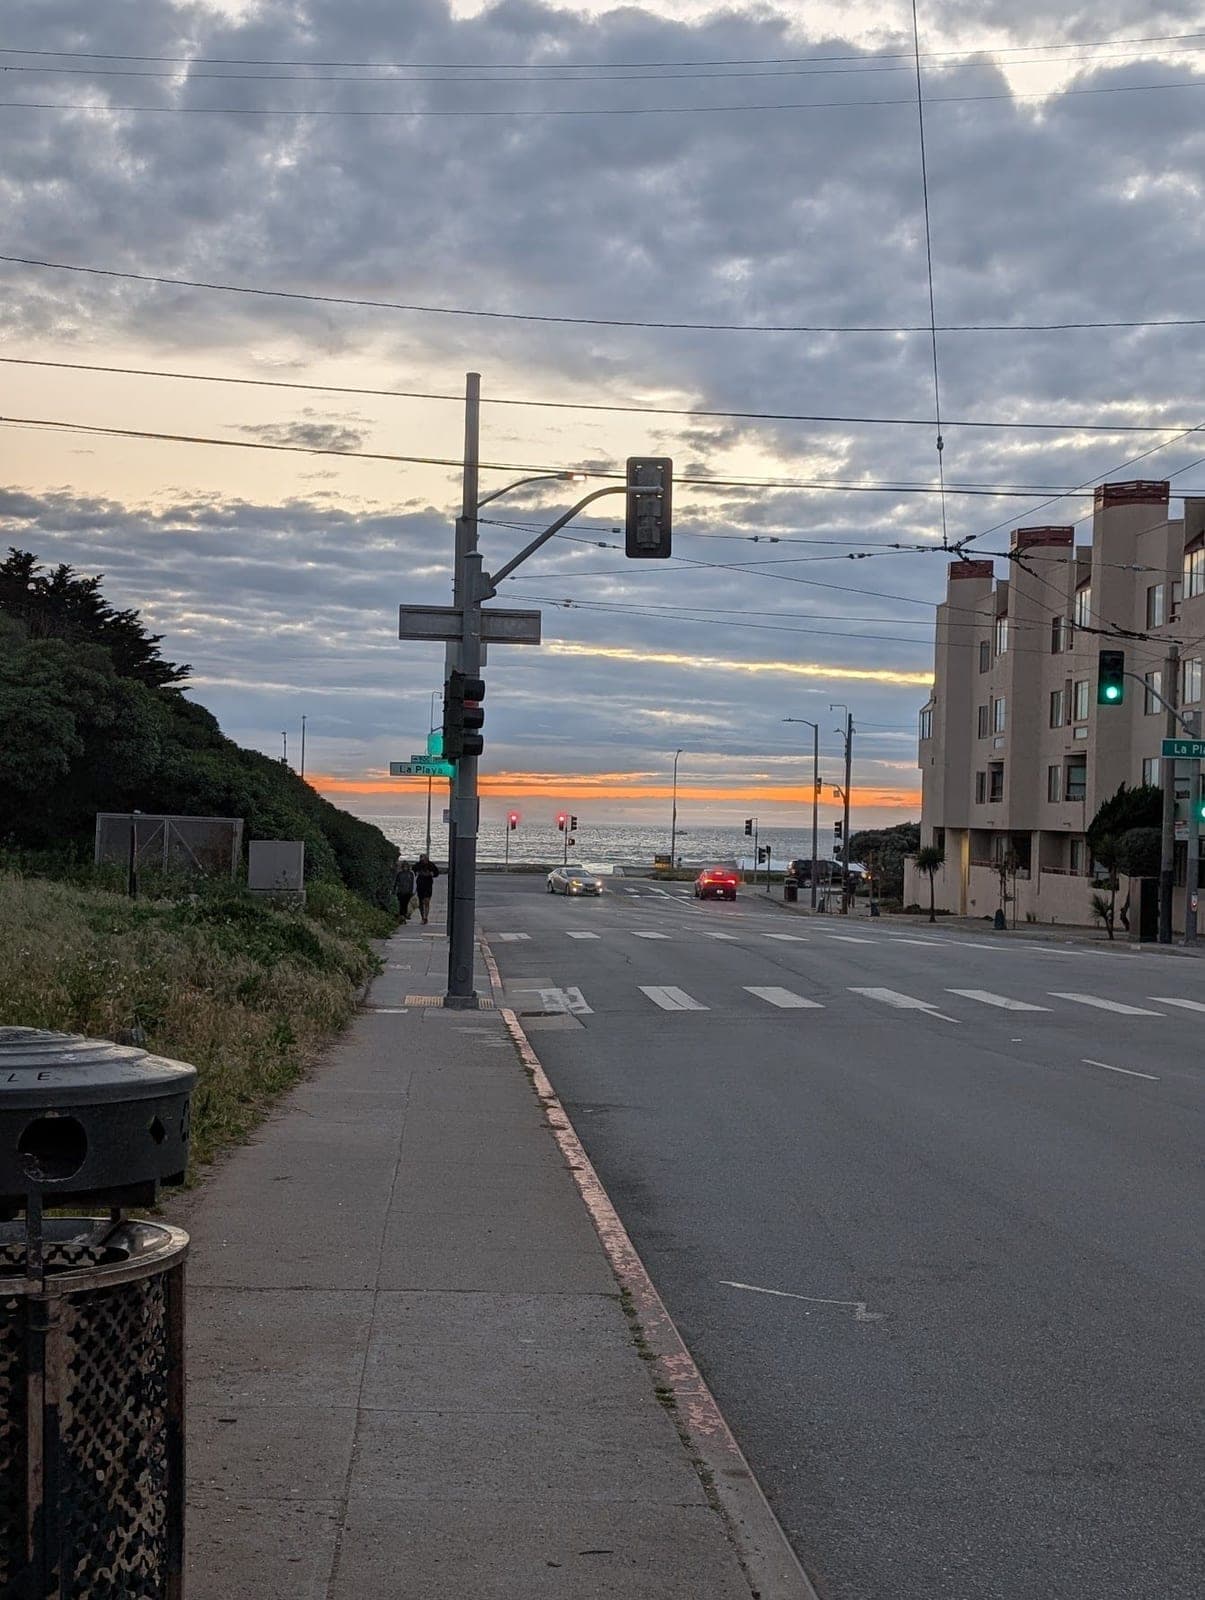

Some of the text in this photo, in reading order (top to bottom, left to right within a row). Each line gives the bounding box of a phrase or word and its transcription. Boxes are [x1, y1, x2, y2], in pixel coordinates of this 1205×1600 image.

[1174, 743, 1187, 754] La
[399, 765, 443, 775] La Playa
